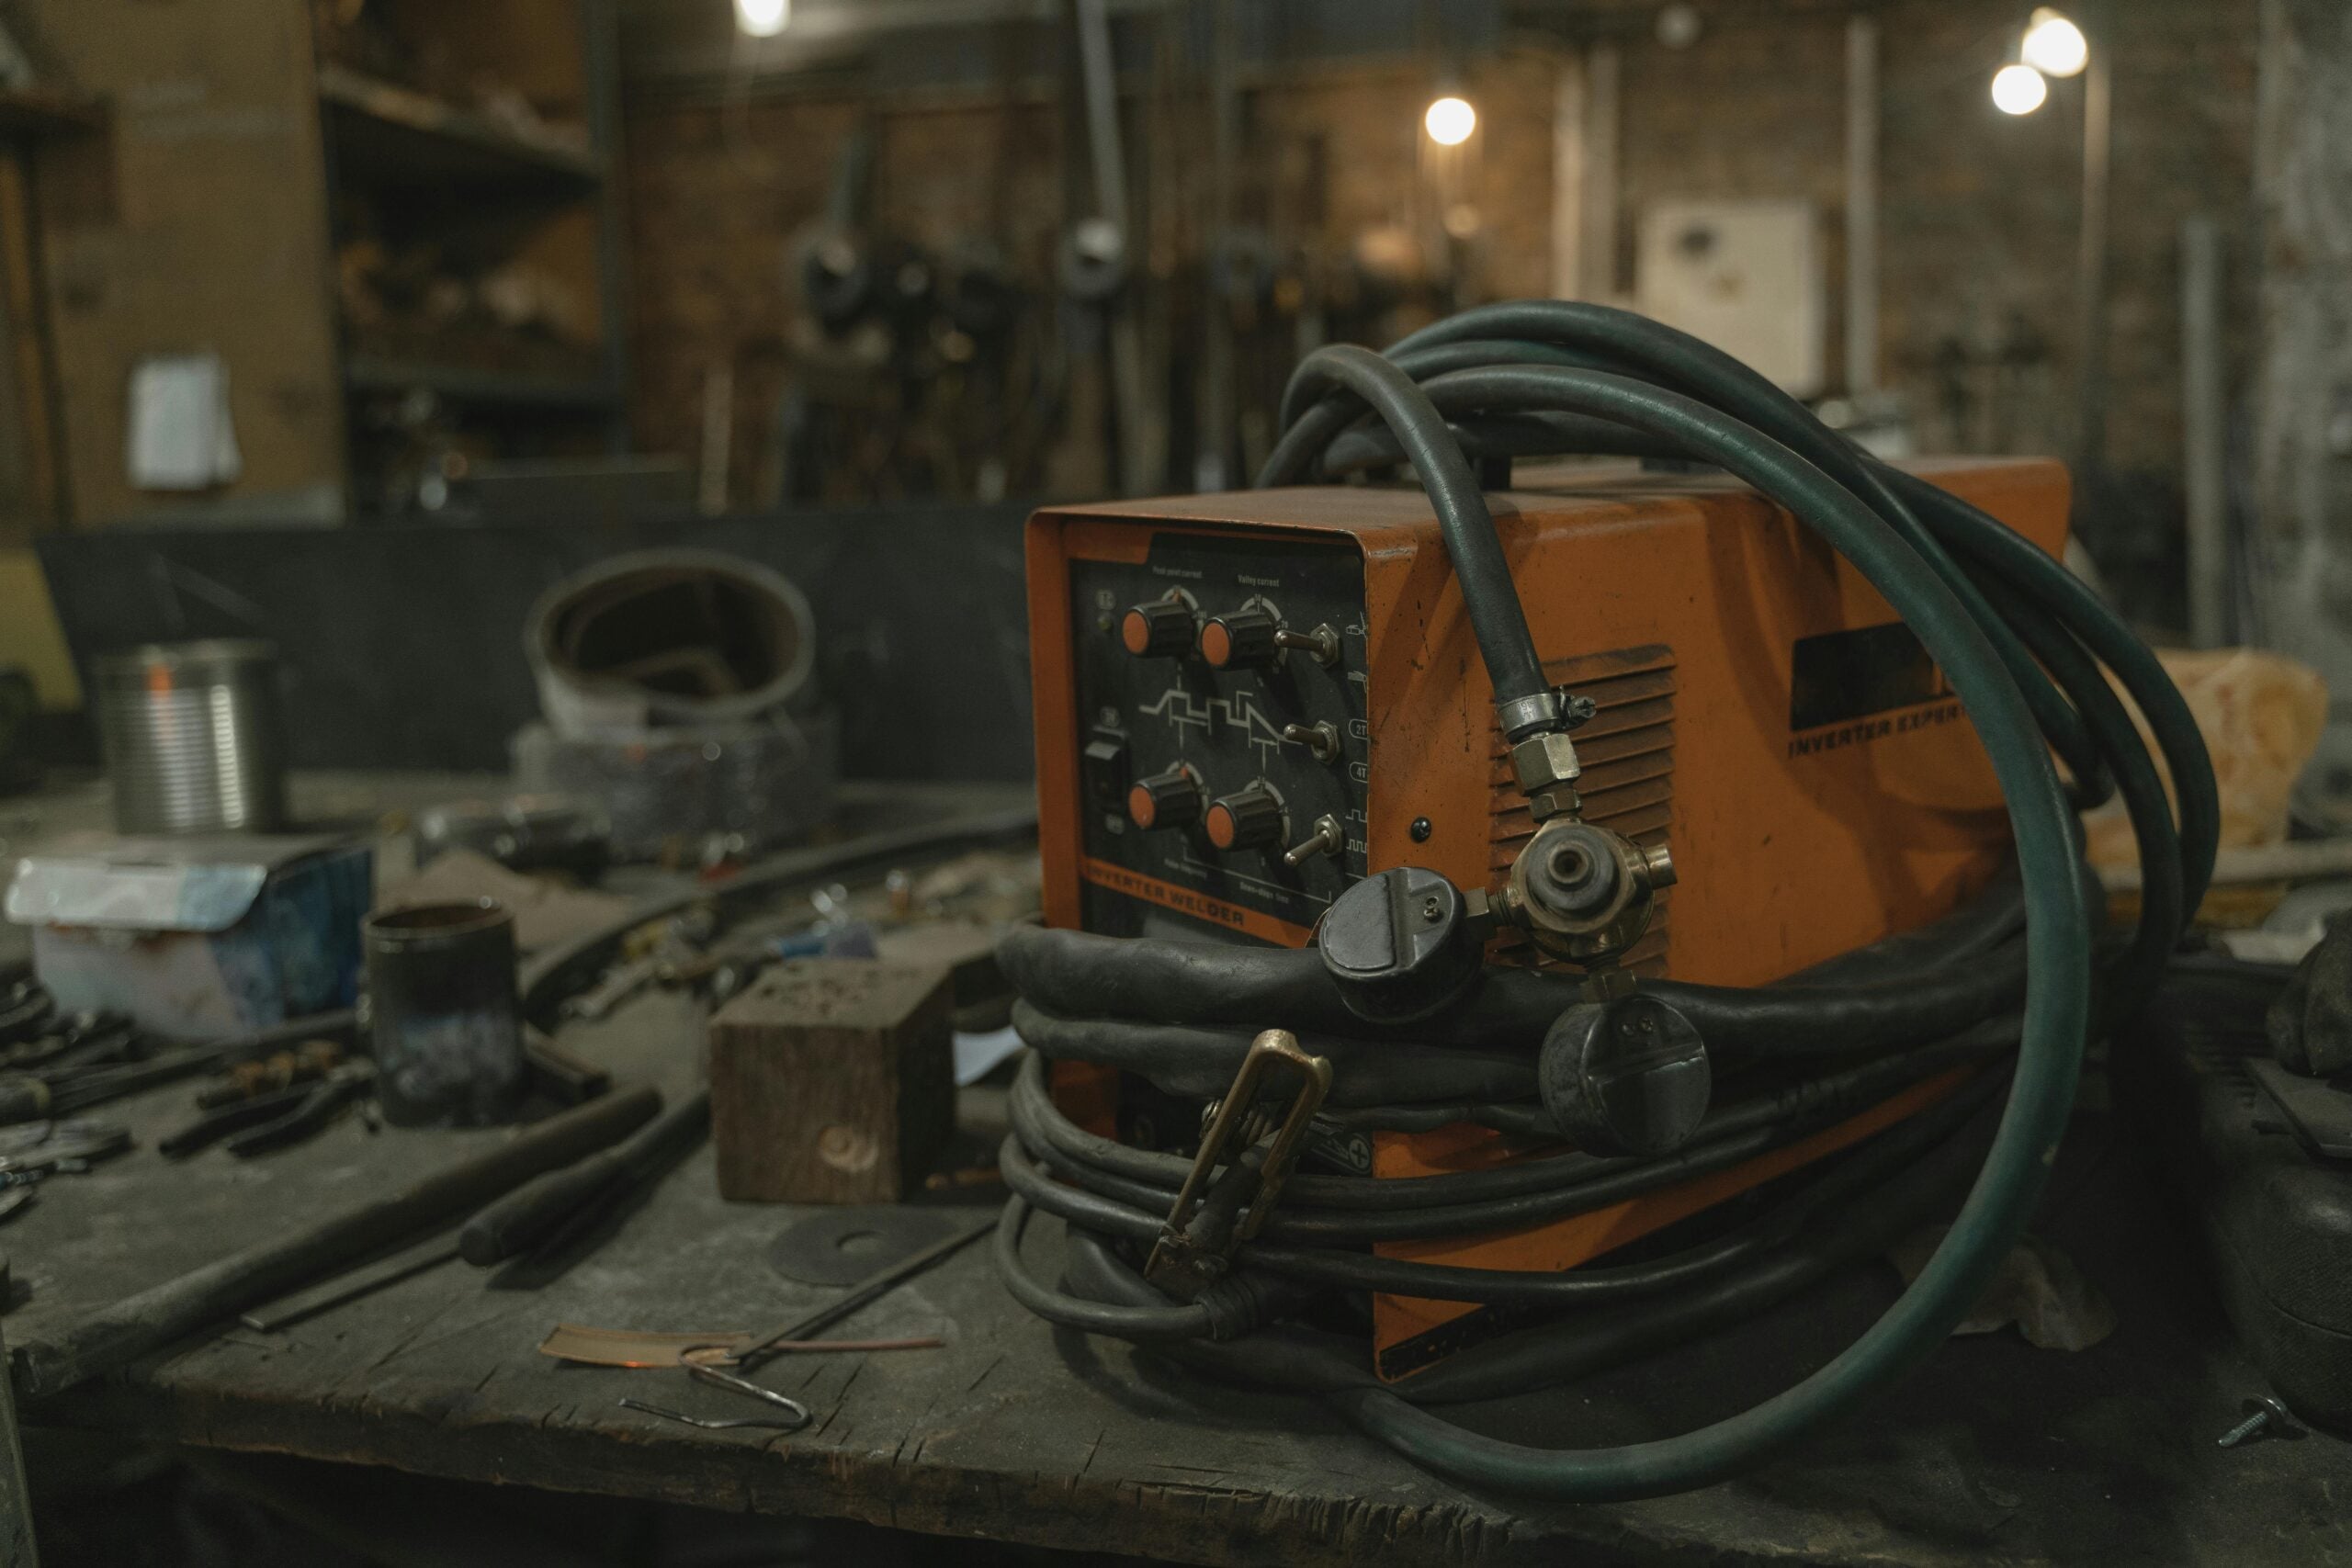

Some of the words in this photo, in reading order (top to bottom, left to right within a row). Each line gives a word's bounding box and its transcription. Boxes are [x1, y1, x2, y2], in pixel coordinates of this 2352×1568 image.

[1238, 574, 1256, 587] Valley
[1257, 579, 1280, 588] current
[1356, 724, 1366, 736] 2T
[1788, 720, 1891, 758] INVERTER
[1356, 767, 1366, 779] 4T
[1088, 865, 1165, 898] INVERTER
[1170, 890, 1244, 926] WELDER
